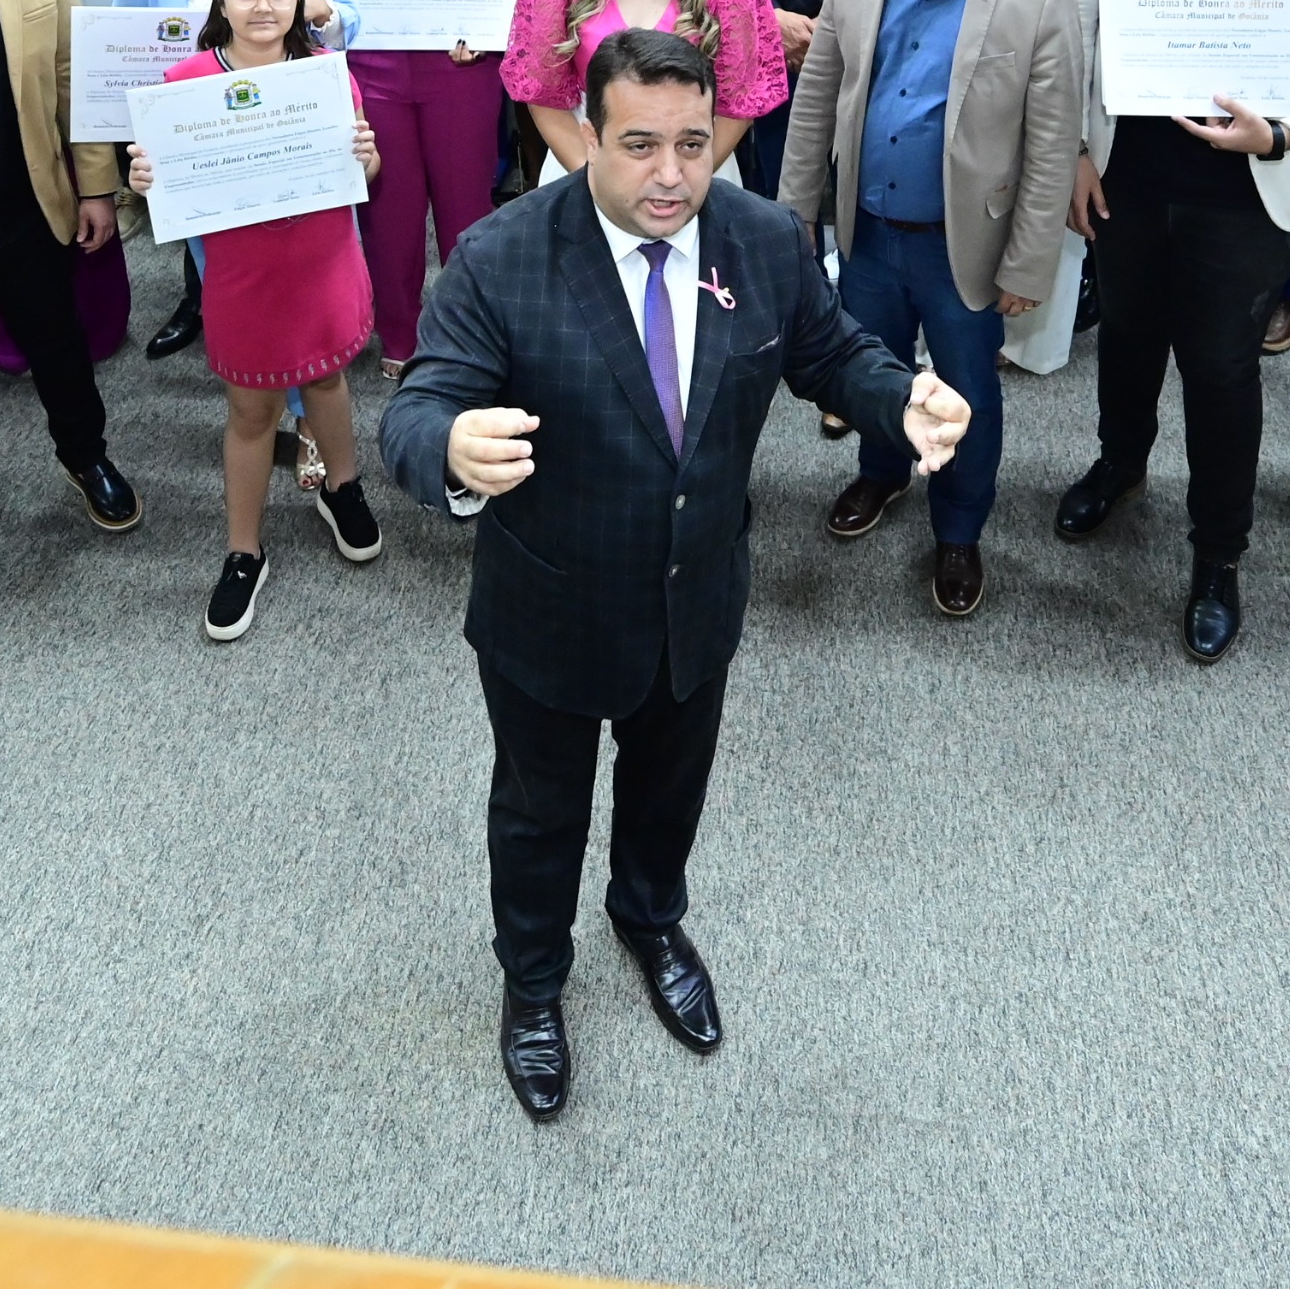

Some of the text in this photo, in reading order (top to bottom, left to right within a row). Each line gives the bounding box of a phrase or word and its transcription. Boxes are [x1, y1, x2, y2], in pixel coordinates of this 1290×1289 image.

[1155, 11, 1269, 20] Câmara Municipal de Goiânia
[105, 44, 192, 54] Diploma de Honra
[1167, 41, 1252, 50] Itamar Batista Neto
[121, 55, 150, 63] Câmara
[104, 79, 128, 89] Sylvia
[173, 100, 318, 135] Diploma de Honra ao Mérito
[193, 116, 306, 143] Câmara Municipal de Goiânia
[192, 141, 313, 171] Ueslei Jânio Campos Morais
